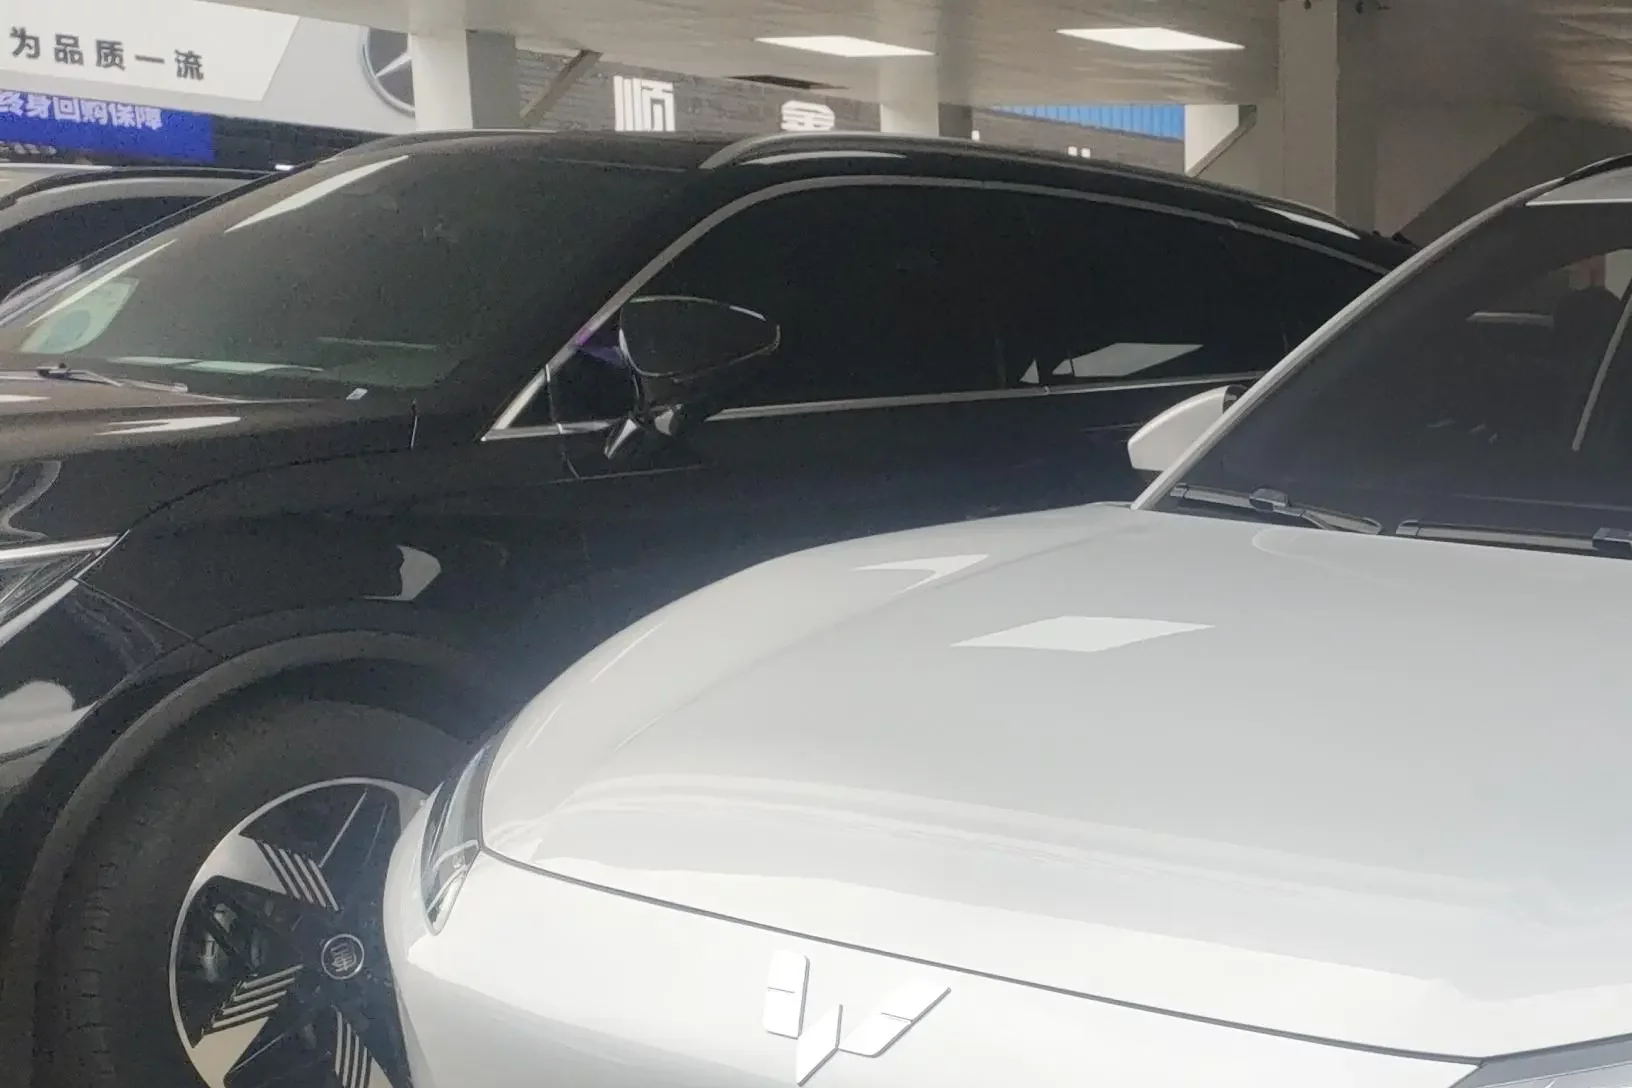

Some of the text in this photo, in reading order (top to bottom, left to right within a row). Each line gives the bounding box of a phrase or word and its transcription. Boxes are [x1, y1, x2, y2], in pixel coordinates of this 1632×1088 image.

[9, 26, 205, 81] 为品质一流
